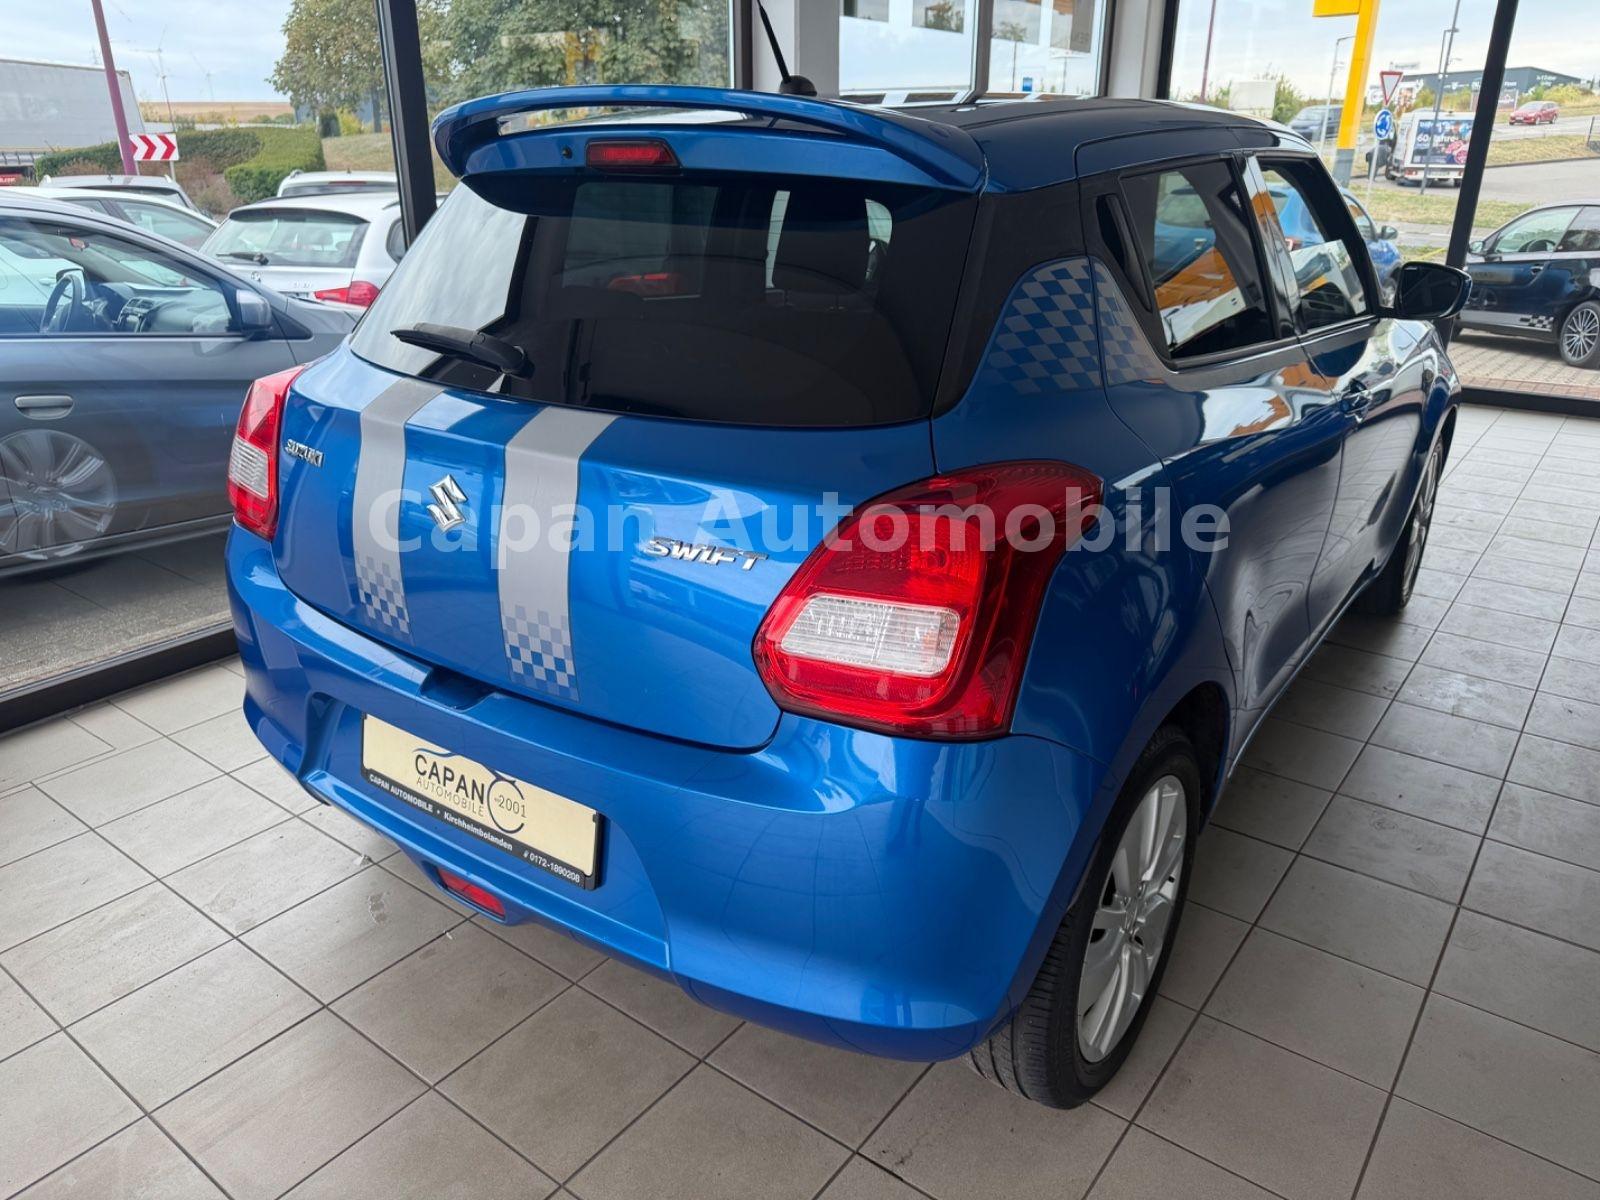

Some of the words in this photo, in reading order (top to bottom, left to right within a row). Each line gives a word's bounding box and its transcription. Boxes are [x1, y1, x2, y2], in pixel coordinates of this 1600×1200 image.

[285, 438, 325, 467] SUZUKI
[643, 536, 769, 571] SWIFT
[415, 754, 485, 805] CAPAN
[416, 777, 484, 817] AUTOMOBILE
[369, 773, 390, 791] CAPAN
[390, 785, 433, 813] AUTOMOBILE
[444, 811, 513, 851] Kirchheimbolanden
[529, 853, 580, 883] 0172-1890208
